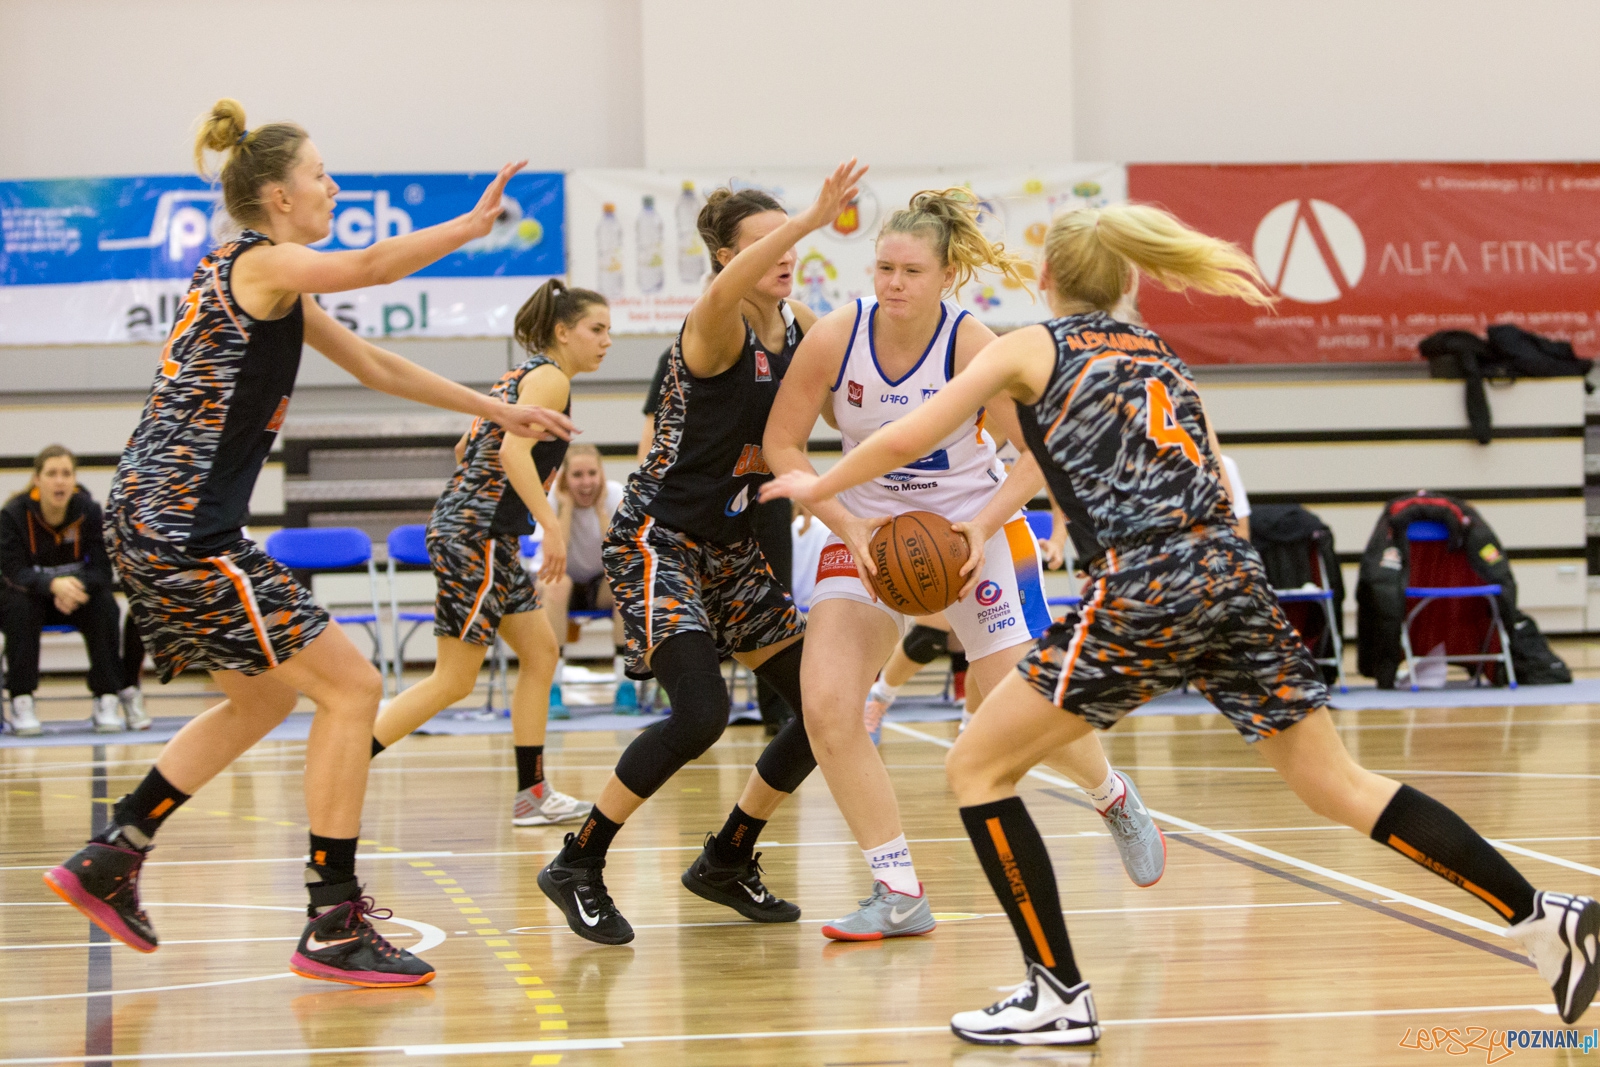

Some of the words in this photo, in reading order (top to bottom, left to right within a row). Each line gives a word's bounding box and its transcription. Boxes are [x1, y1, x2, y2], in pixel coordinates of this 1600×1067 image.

[1378, 241, 1468, 276] ALFA
[1144, 376, 1202, 469] 4
[901, 481, 938, 492] Motors
[876, 539, 910, 607] SPALDING
[906, 536, 934, 592] TF-250
[977, 602, 1010, 619] POZNAŃ
[978, 616, 990, 625] CITY
[990, 609, 1011, 621] CENTER
[577, 817, 598, 849] BASKET
[999, 852, 1031, 903] BASKET
